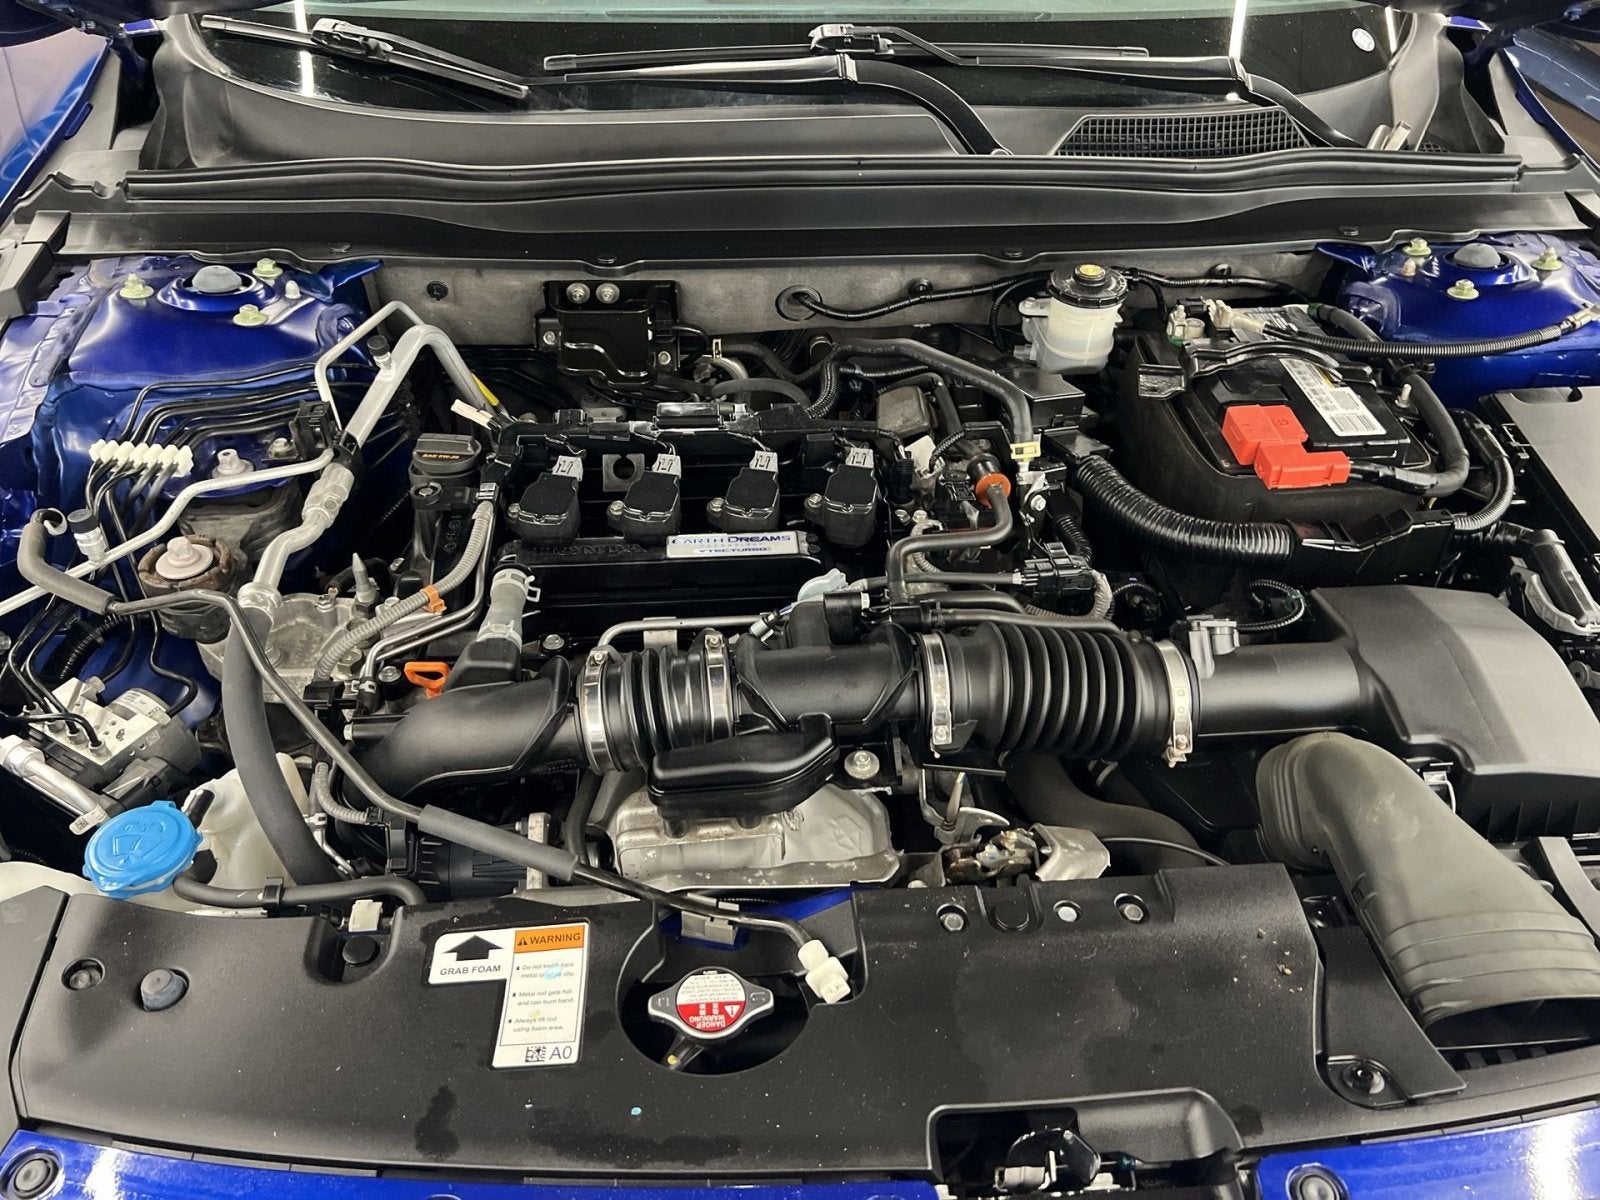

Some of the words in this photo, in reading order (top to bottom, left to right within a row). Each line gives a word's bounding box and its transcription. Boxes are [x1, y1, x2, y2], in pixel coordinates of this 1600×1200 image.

[727, 535, 791, 543] DREAMS
[529, 933, 581, 945] WARNING
[440, 965, 469, 976] GRAB
[472, 964, 501, 974] FOAM
[689, 1014, 725, 1023] WARNUNG
[696, 1020, 726, 1029] DANGER
[549, 1045, 572, 1060] A0
